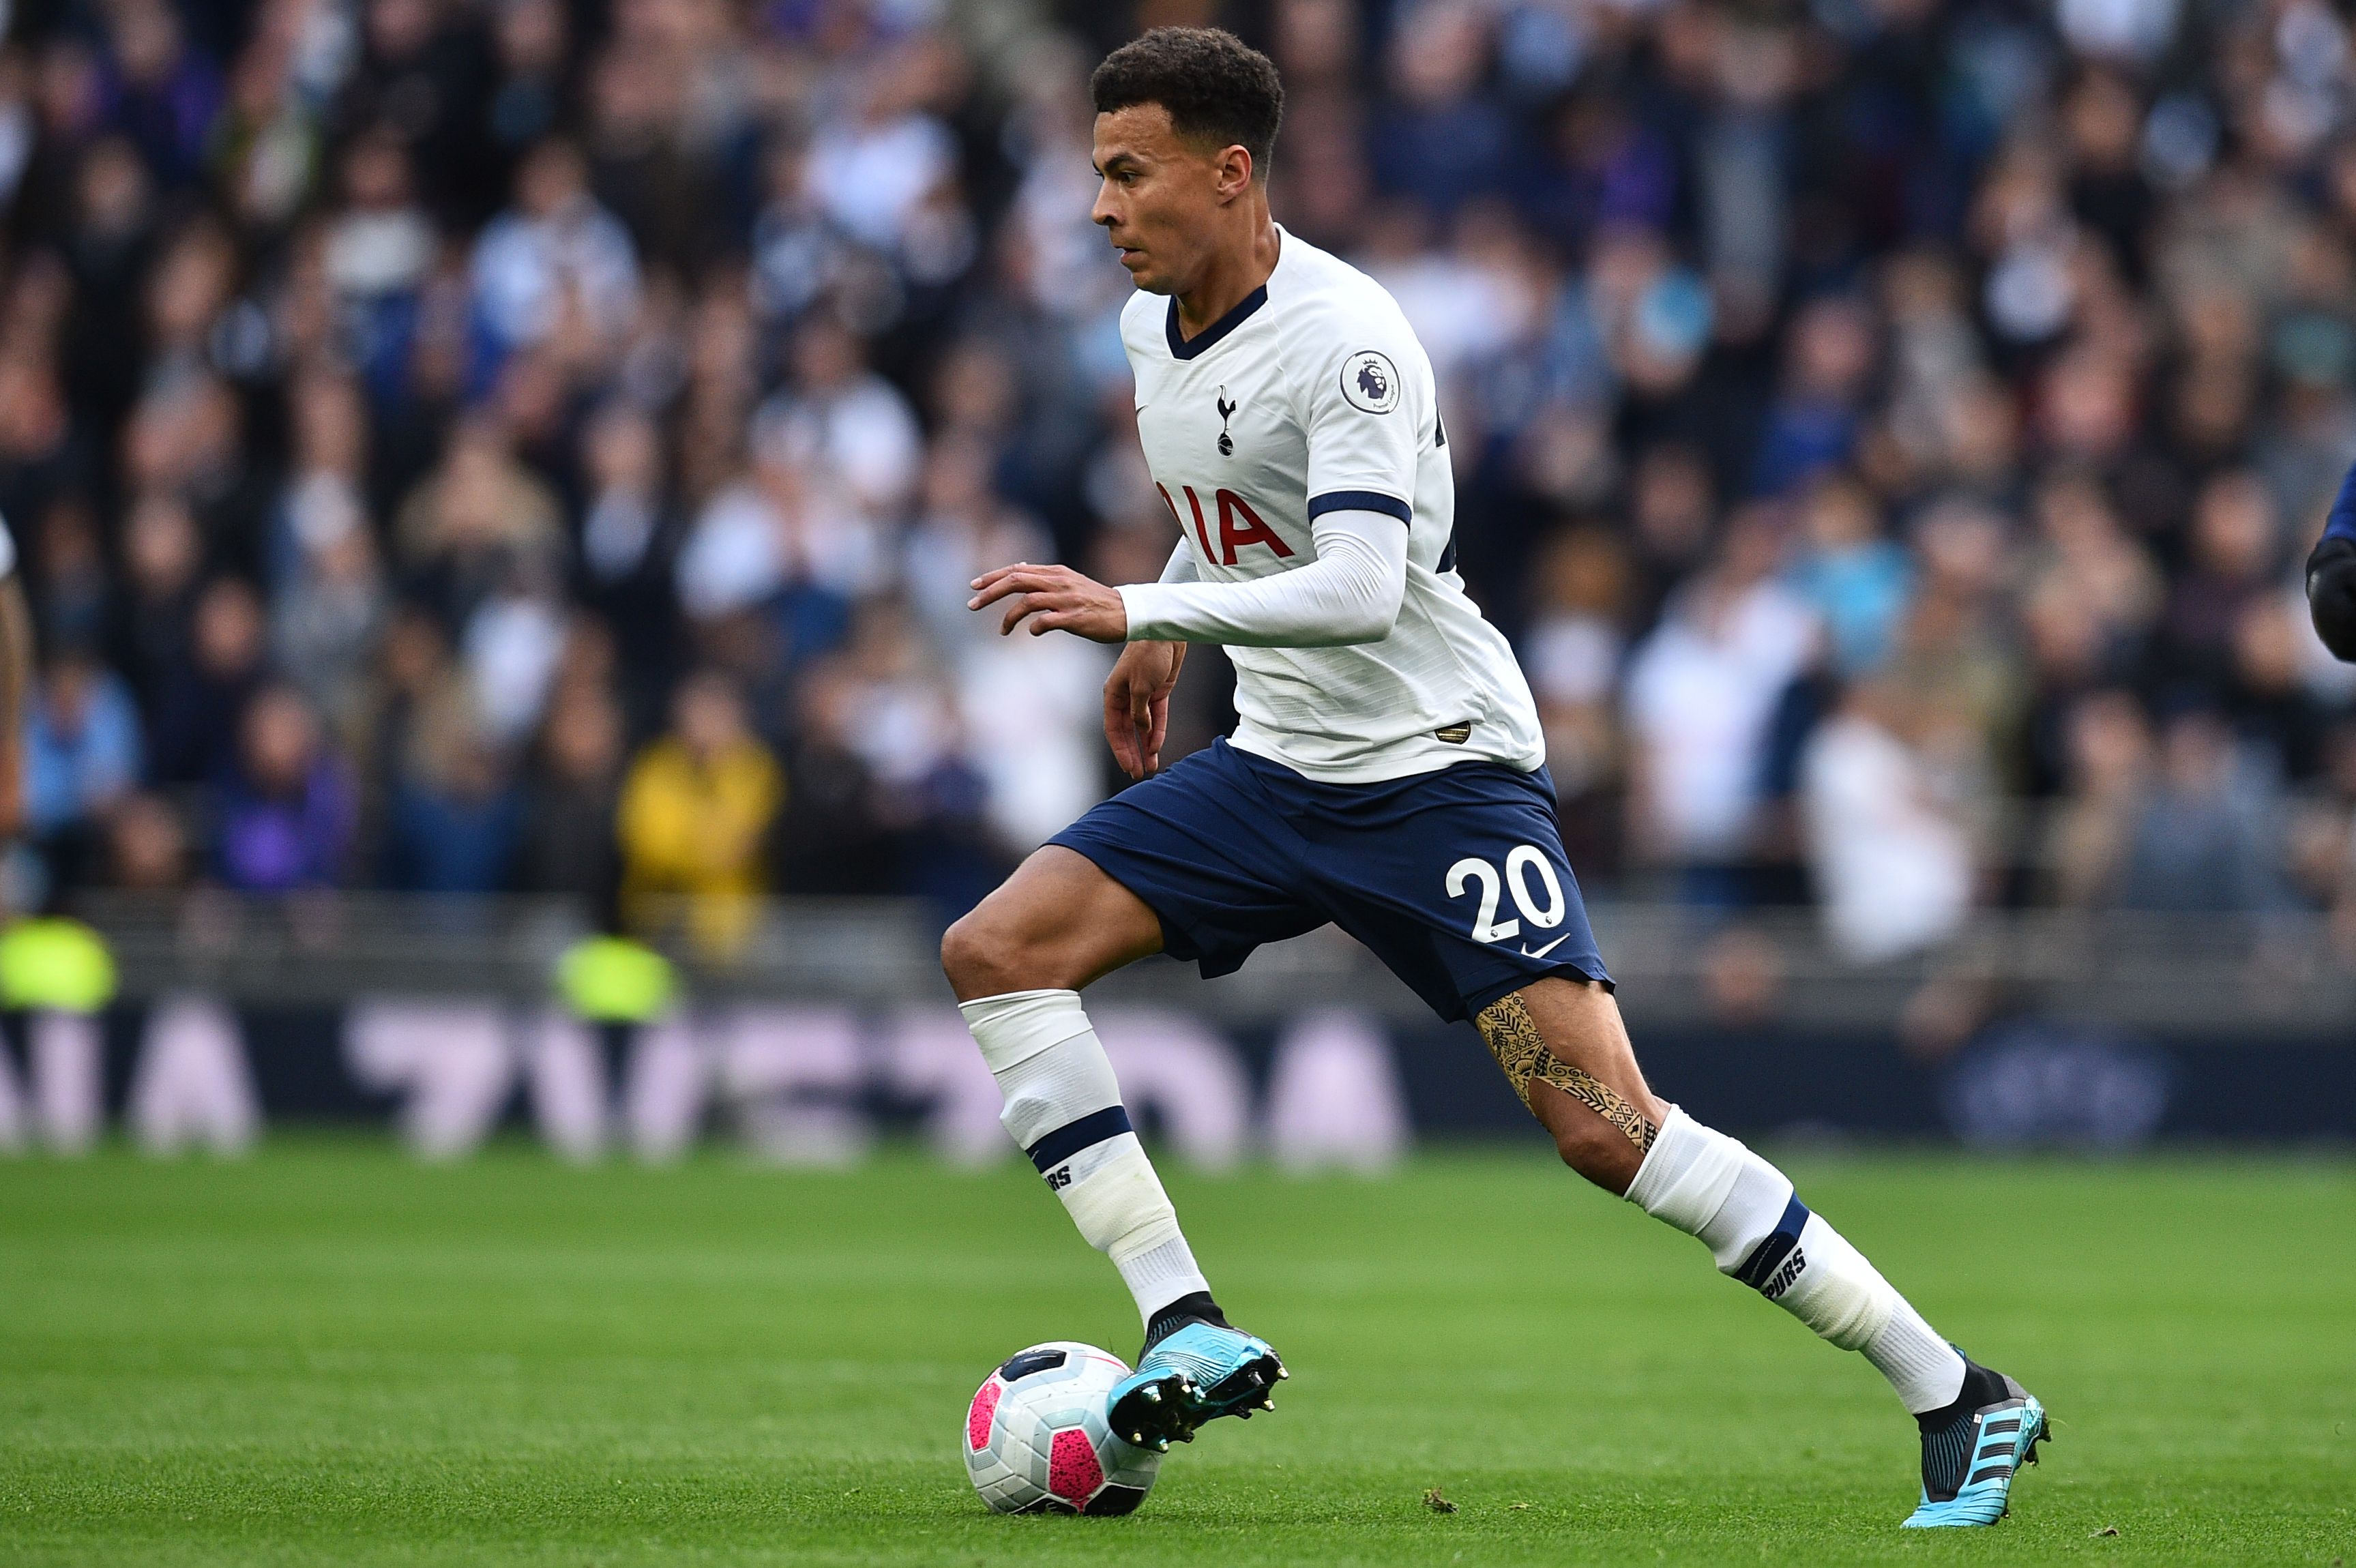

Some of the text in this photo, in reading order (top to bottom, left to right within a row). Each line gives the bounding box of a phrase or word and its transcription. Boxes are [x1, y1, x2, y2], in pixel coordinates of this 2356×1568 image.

[1445, 844, 1565, 944] 20
[1044, 1165, 1072, 1192] RS
[1761, 1247, 1807, 1301] PURS
